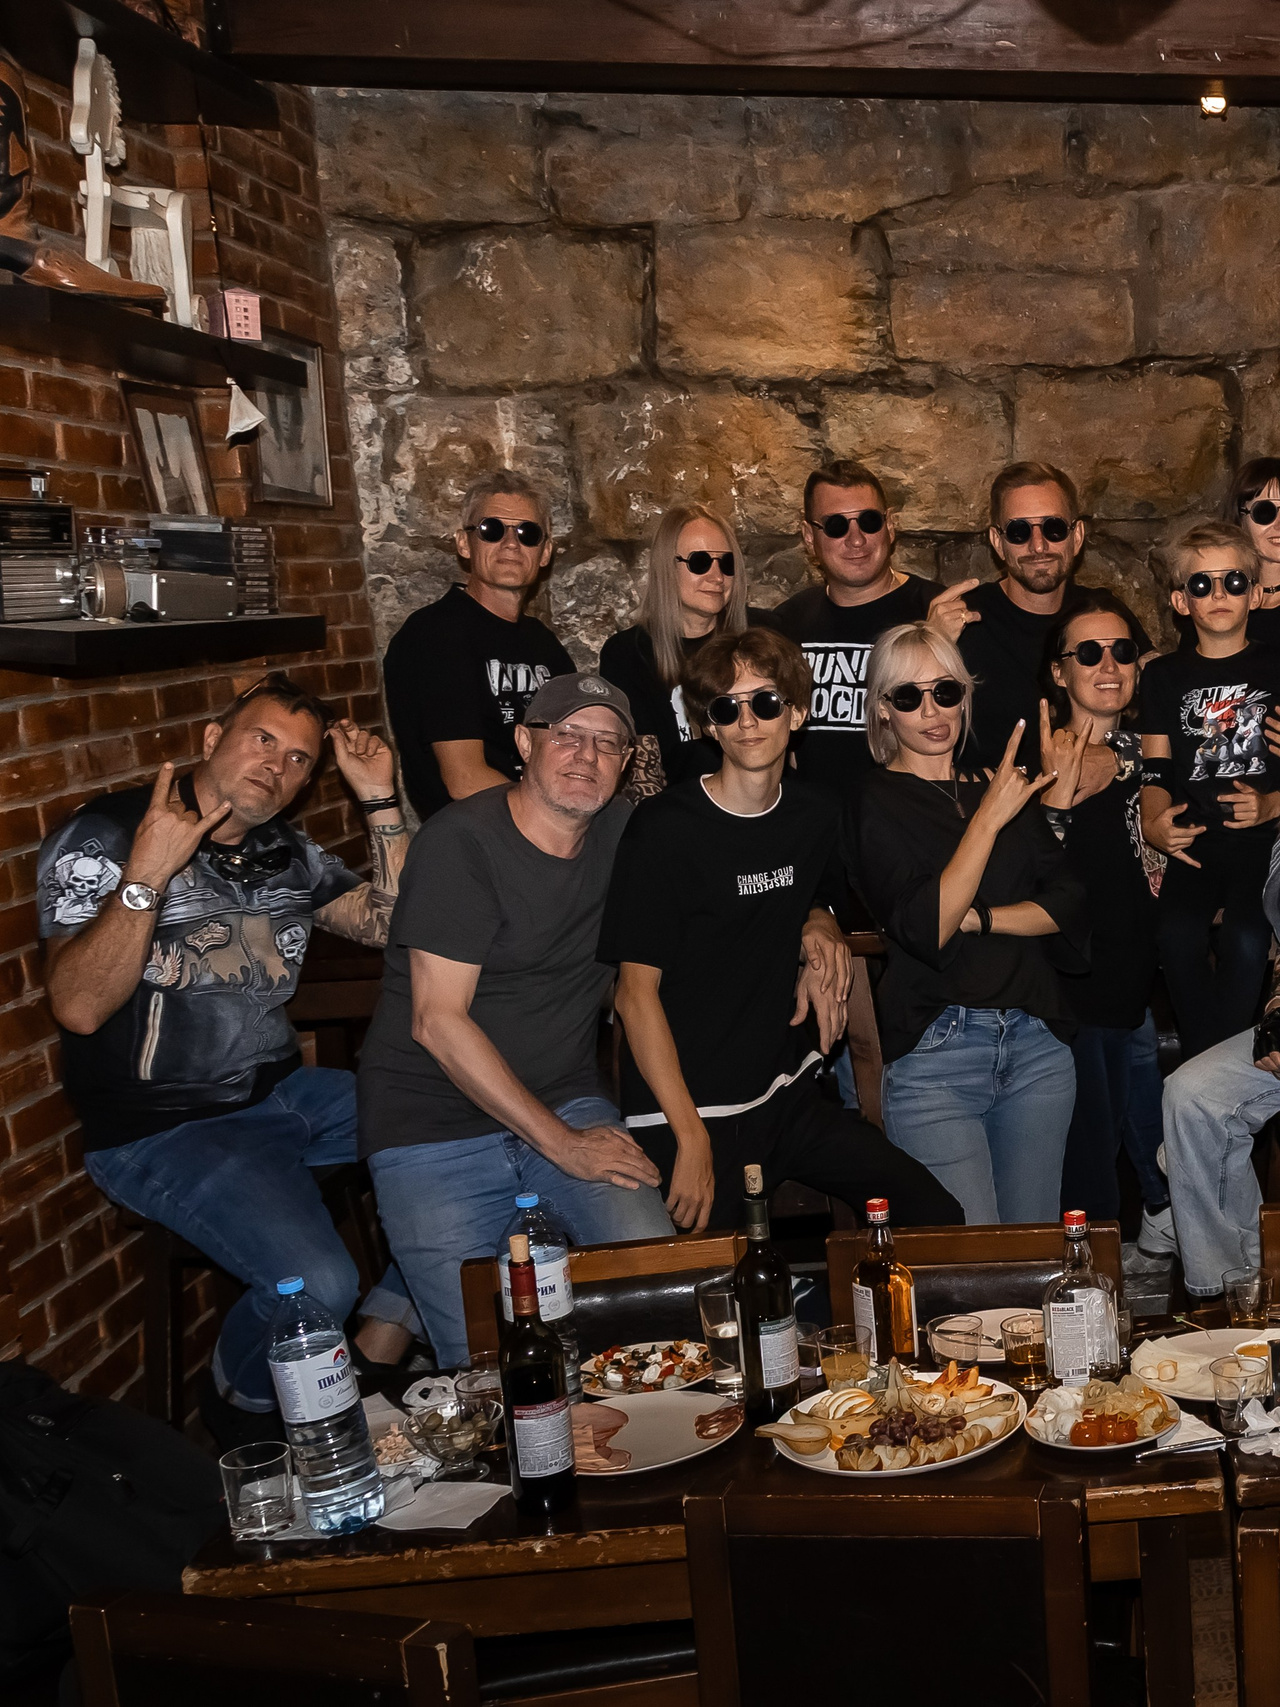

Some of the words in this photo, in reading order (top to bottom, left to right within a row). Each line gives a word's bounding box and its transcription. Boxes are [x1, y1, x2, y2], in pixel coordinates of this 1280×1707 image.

[737, 872, 769, 885] CHANGE
[771, 865, 794, 879] YOUR
[738, 875, 794, 895] PERSPECTIVE
